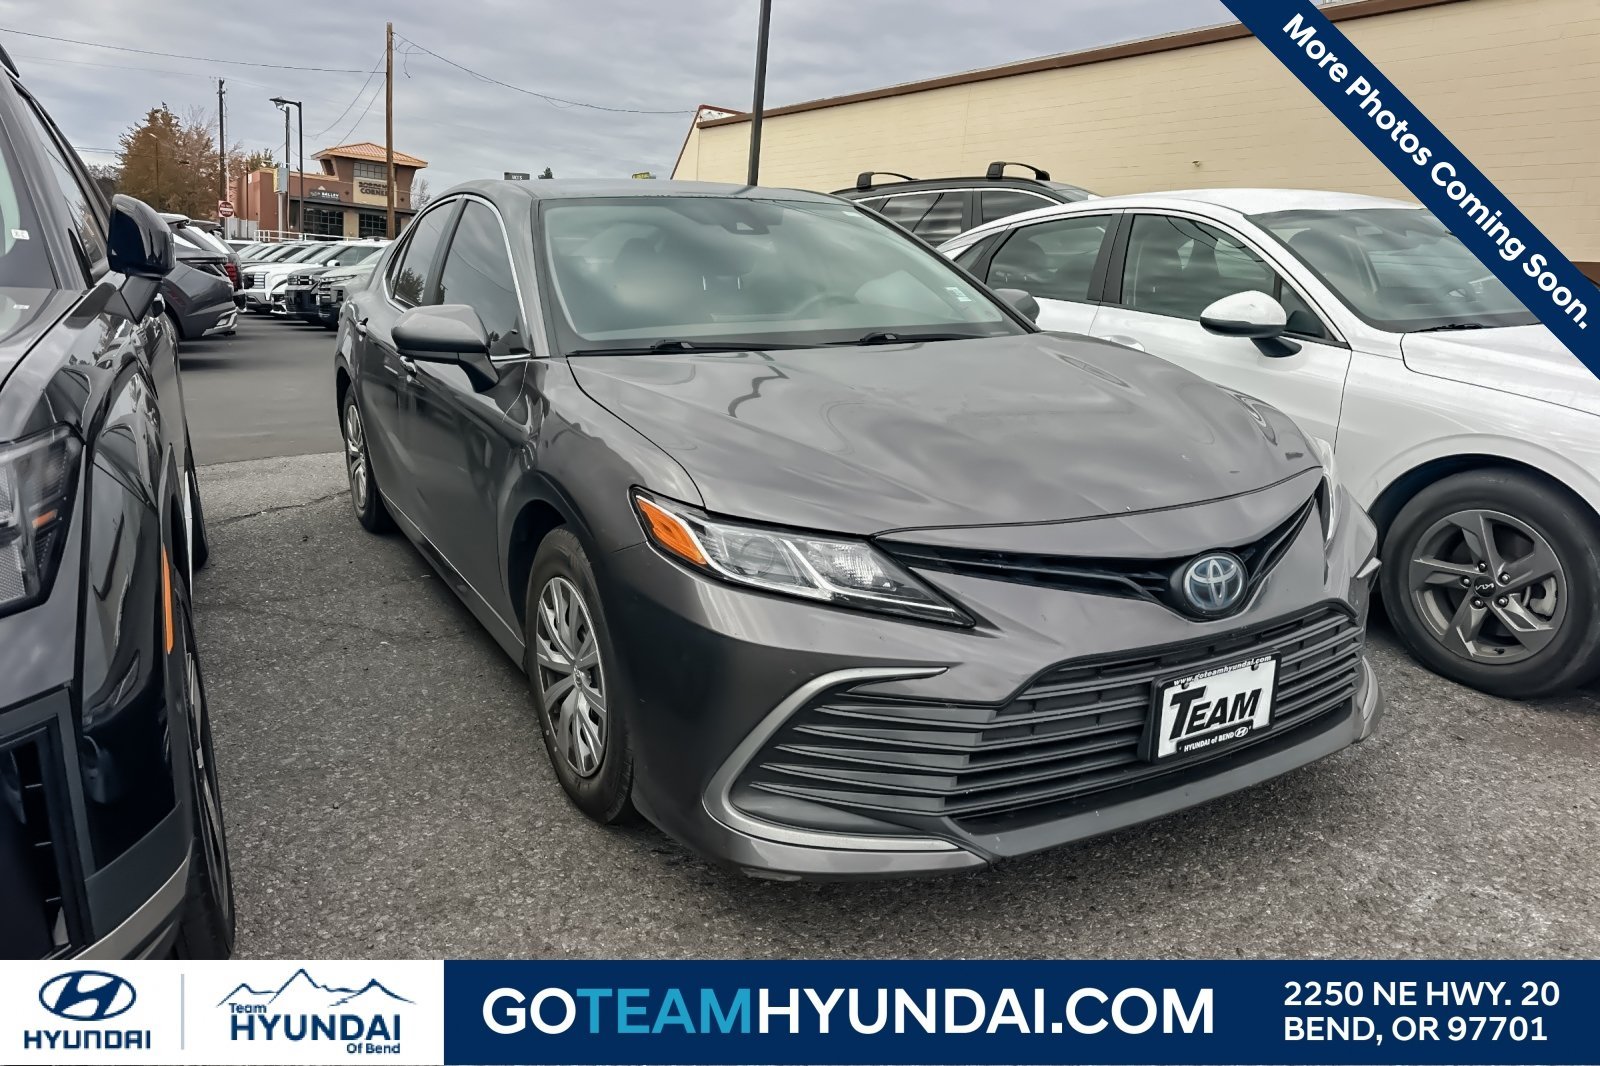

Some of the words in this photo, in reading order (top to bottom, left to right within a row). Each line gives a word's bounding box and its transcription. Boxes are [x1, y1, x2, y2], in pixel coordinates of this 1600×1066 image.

[1173, 655, 1272, 686] www.goteamhyundai.com
[1184, 739, 1211, 752] HYUNDAI
[1210, 736, 1218, 744] of
[1218, 732, 1235, 742] BEND
